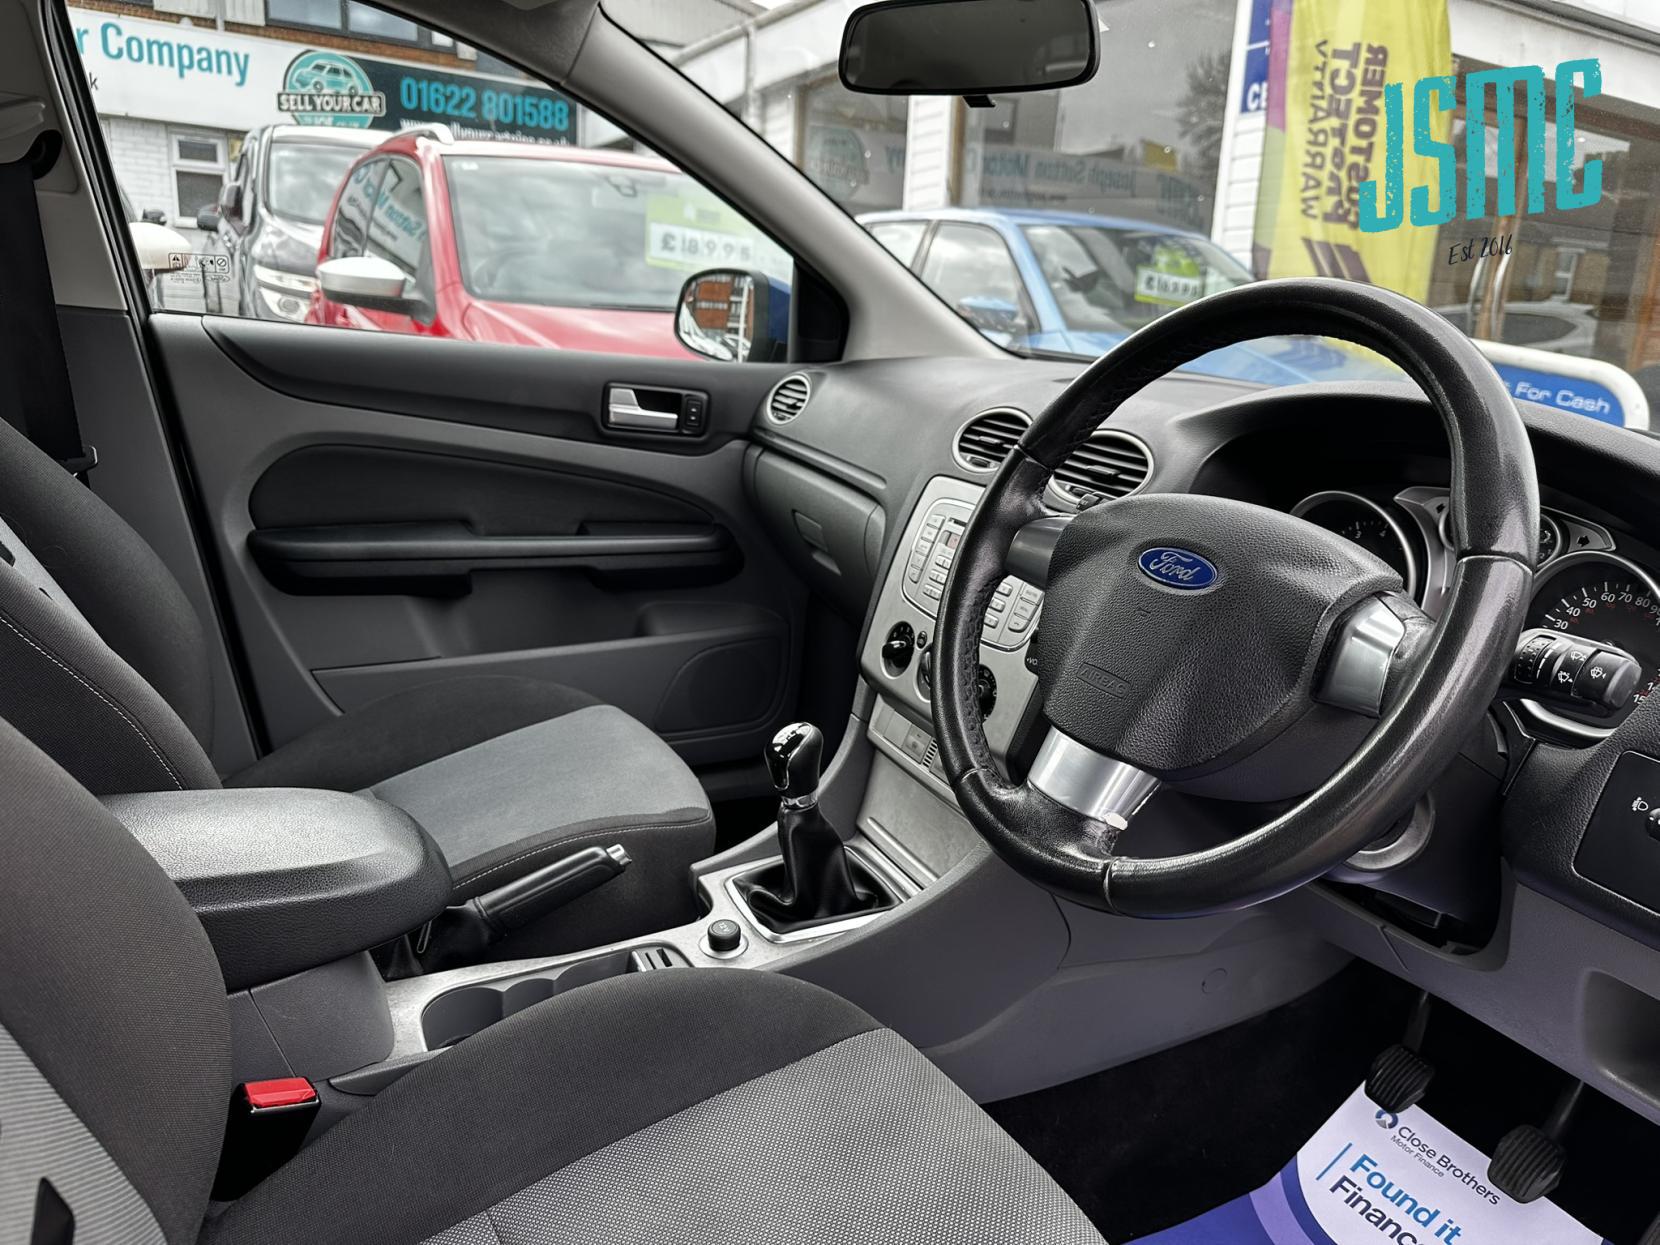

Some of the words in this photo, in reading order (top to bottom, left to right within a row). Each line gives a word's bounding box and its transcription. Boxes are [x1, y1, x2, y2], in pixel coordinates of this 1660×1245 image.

[101, 22, 249, 87] Company
[279, 93, 313, 112] SELL
[312, 95, 351, 112] YOUR
[351, 96, 381, 113] CAR
[401, 76, 477, 118] 01622
[481, 89, 569, 131] 801588
[1514, 381, 1552, 401] For
[1556, 389, 1611, 415] Cash
[1149, 551, 1201, 581] Ford
[1566, 606, 1581, 617] 40
[1582, 598, 1597, 609] 50
[1600, 592, 1616, 603] 60
[1618, 592, 1633, 603] 70
[1634, 596, 1650, 608] 80
[1554, 619, 1569, 630] 30
[1390, 1135, 1414, 1155] Motor
[1414, 1153, 1445, 1178] Finance
[1398, 1126, 1437, 1159] Close
[1436, 1154, 1501, 1205] Brothers
[1329, 1175, 1424, 1245] Financ
[1349, 1153, 1441, 1228] Found
[1434, 1219, 1462, 1245] it
